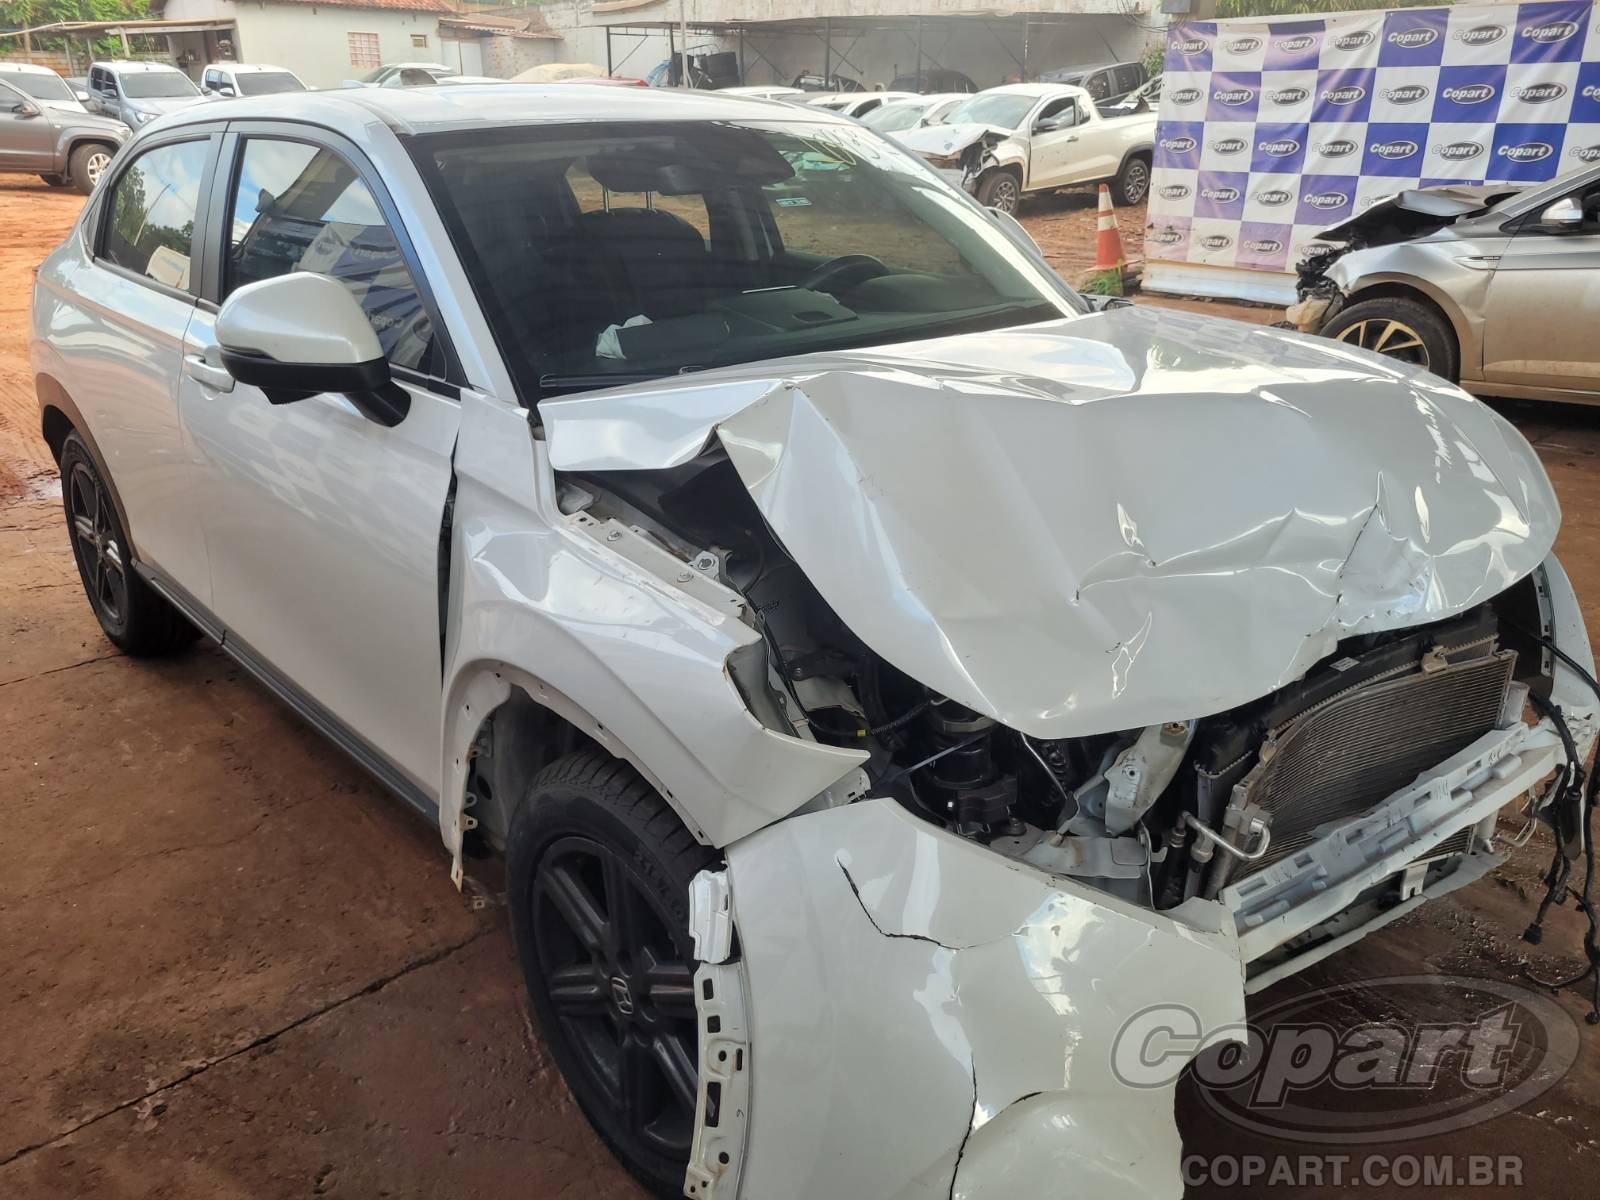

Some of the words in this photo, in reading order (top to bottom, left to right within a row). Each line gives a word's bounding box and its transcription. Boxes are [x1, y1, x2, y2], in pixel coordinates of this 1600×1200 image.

[1453, 26, 1501, 41] Copart
[1521, 23, 1570, 38] Copart
[1388, 31, 1431, 43] Copart
[1171, 40, 1203, 50] Copart
[1274, 38, 1310, 49] Copart
[1214, 91, 1248, 102] Copart
[1320, 89, 1359, 101] Copart
[1380, 87, 1421, 100] Copart
[1443, 87, 1487, 100] Copart
[1510, 85, 1557, 98] Copart
[1160, 139, 1192, 149] Copart
[1259, 141, 1294, 152] Copart
[1369, 142, 1412, 155] Copart
[1432, 143, 1475, 156] Copart
[1498, 145, 1543, 157] Copart
[1253, 192, 1286, 203] opart
[1304, 194, 1341, 205] Copart
